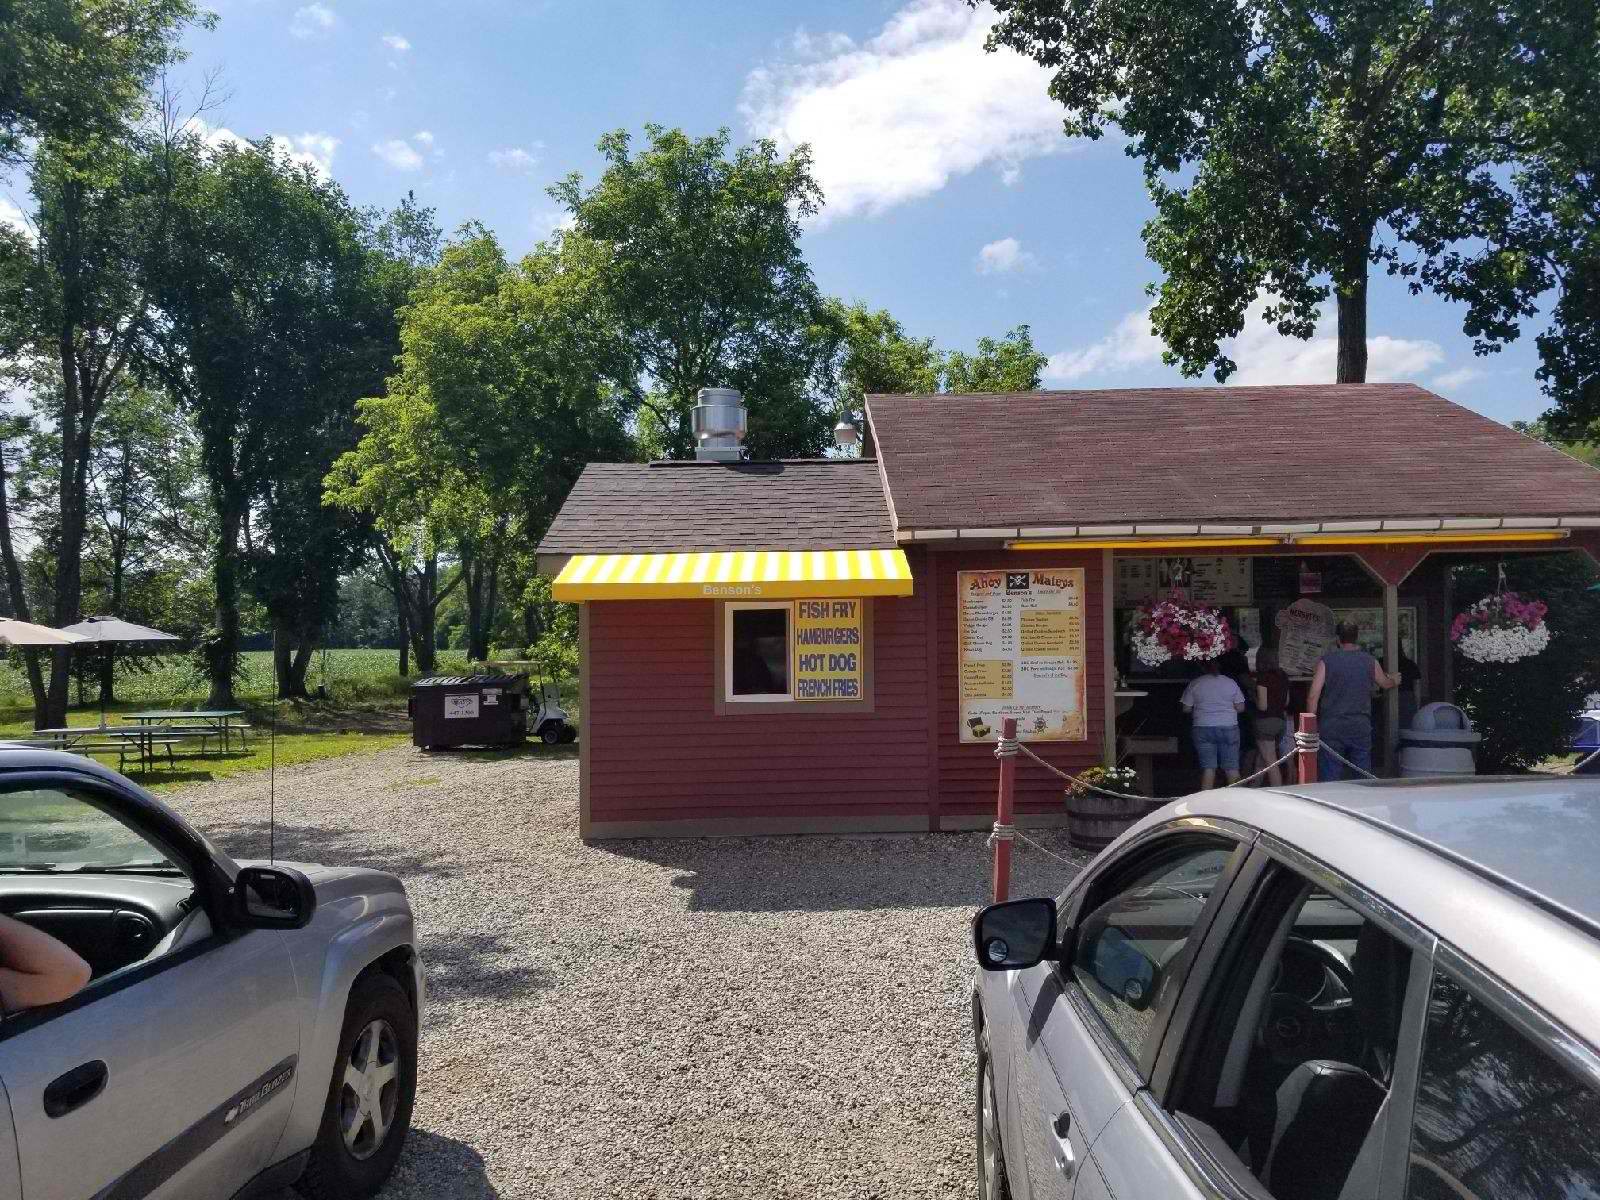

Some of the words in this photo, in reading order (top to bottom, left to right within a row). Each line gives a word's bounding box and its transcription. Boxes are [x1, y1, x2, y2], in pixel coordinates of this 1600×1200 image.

[703, 584, 761, 595] Benson's
[970, 577, 1001, 590] Ahoy
[1032, 574, 1074, 589] Mateys
[799, 602, 830, 619] FISH
[832, 602, 857, 618] FRY
[797, 627, 859, 645] HAMBURGERS
[799, 653, 826, 672] HOT
[829, 653, 857, 672] DOG
[798, 678, 832, 697] FRENCH
[832, 678, 859, 697] FRIES
